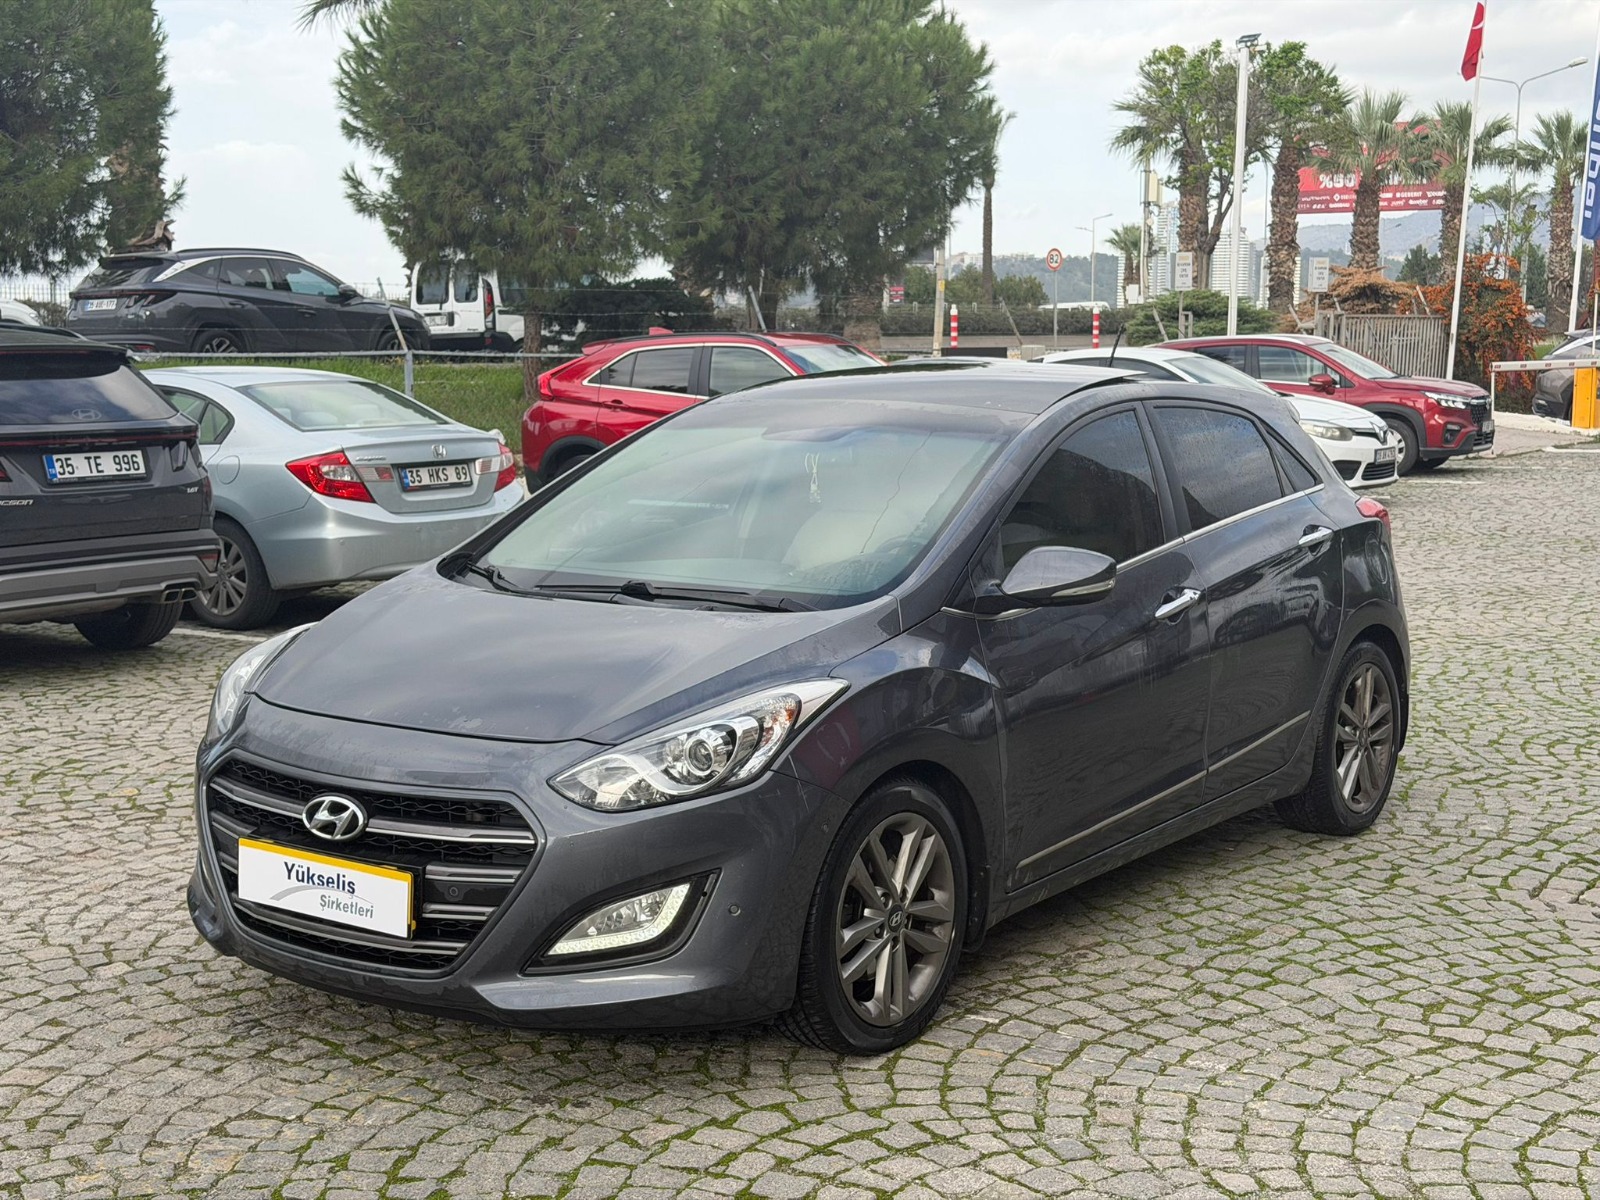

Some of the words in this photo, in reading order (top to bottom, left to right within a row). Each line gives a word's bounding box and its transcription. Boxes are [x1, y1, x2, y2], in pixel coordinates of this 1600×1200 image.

[1050, 254, 1059, 264] 82
[55, 457, 75, 476] 35
[84, 456, 104, 474] TE
[113, 454, 140, 472] 996
[408, 469, 423, 484] 35
[427, 467, 449, 483] HKS
[455, 466, 468, 480] 89
[283, 861, 356, 899] Yükseliş
[319, 894, 374, 919] Şirketleri
